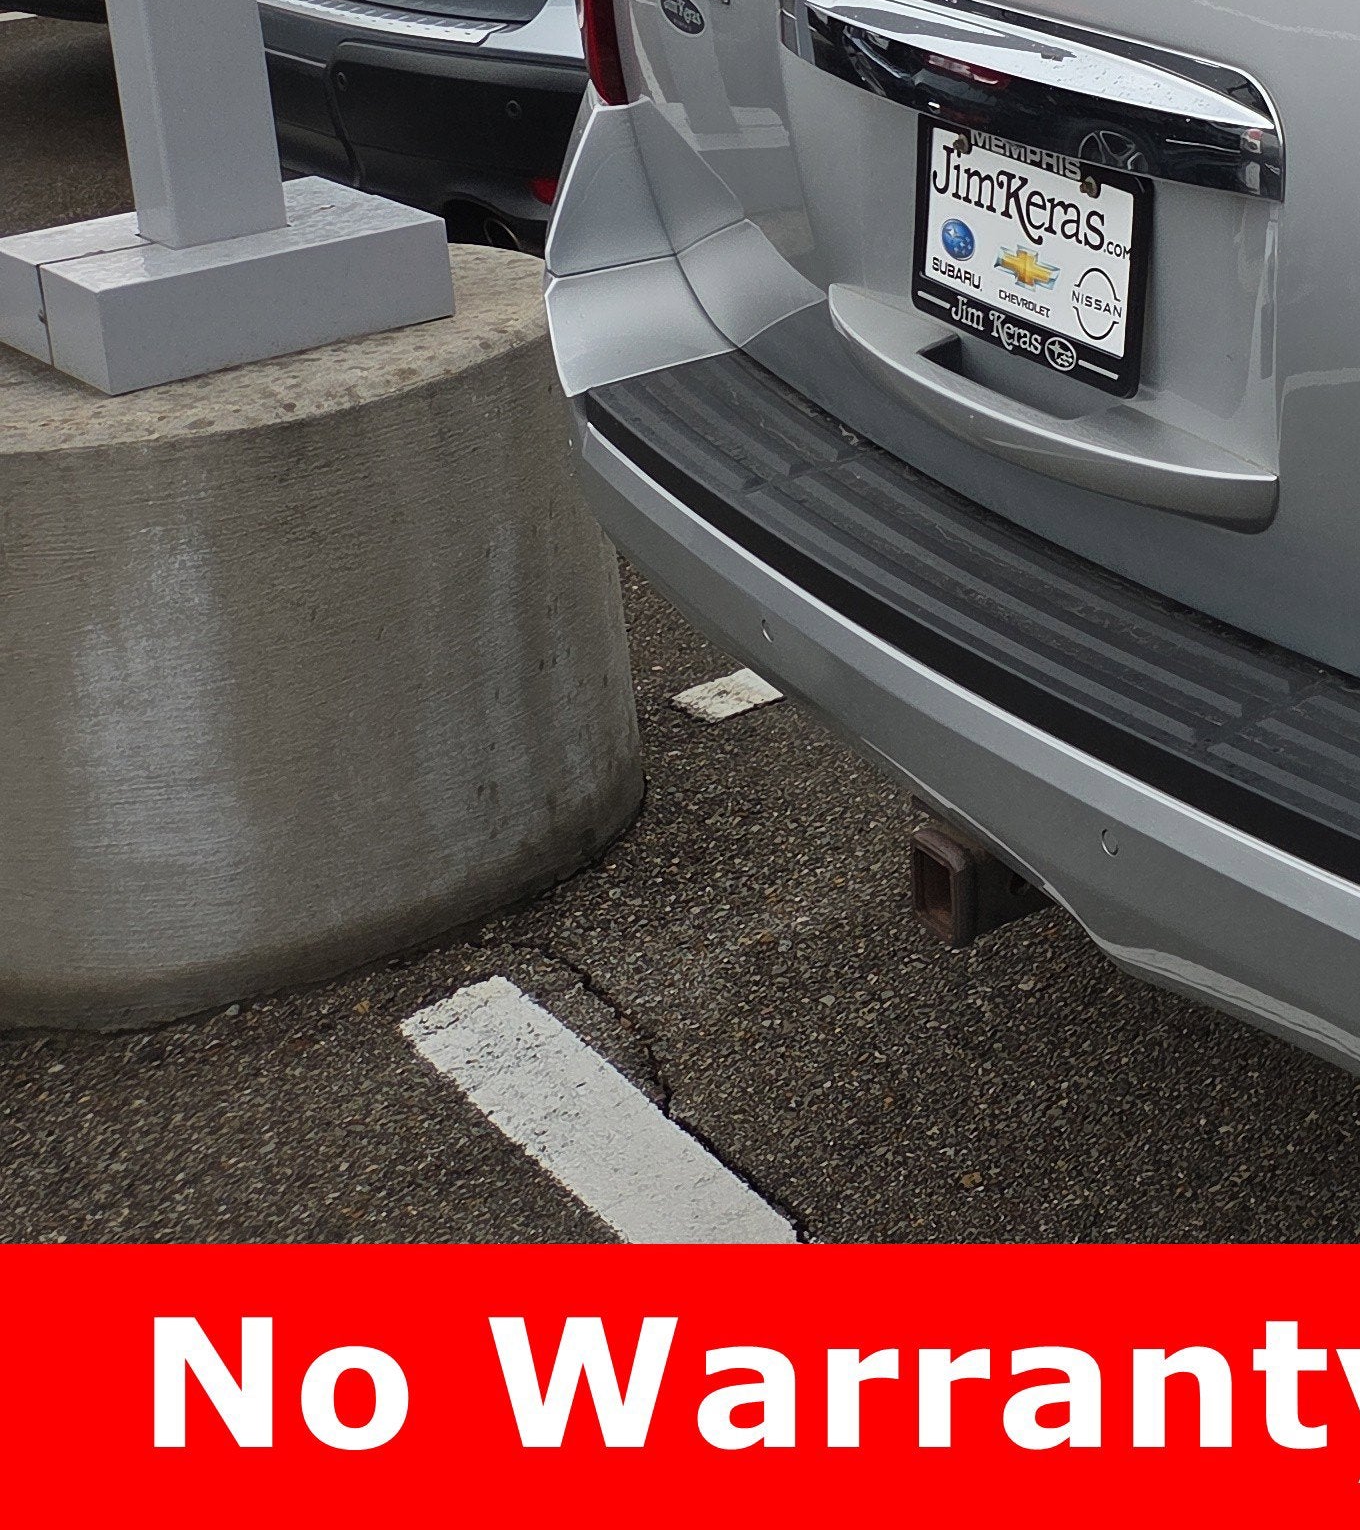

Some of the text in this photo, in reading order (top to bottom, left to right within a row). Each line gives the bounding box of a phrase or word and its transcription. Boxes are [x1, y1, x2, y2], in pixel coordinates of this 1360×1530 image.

[970, 129, 1082, 181] MEMPHIS
[932, 256, 982, 290] SUBARU
[998, 289, 1051, 318] CHEVROLET
[1072, 290, 1122, 318] NISSAN
[951, 296, 1042, 355] Jim Keras
